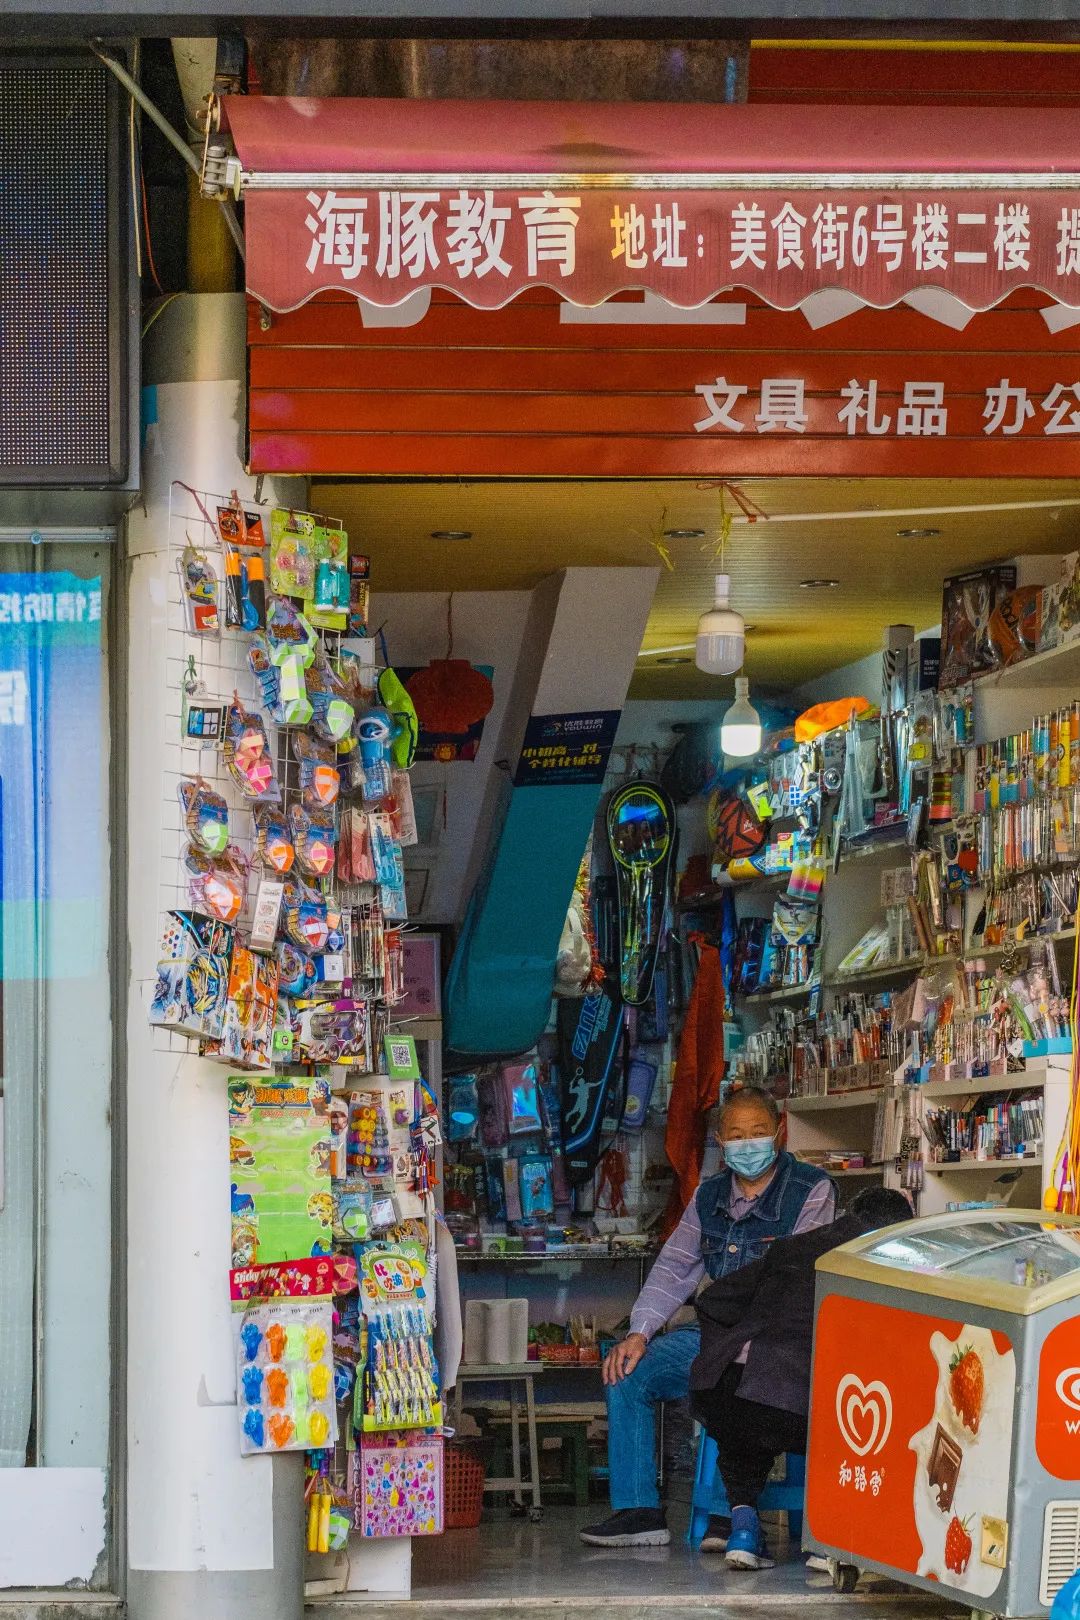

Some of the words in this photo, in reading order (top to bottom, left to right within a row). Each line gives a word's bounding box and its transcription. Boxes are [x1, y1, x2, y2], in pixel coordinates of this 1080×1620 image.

[305, 190, 582, 279] 海豚教育
[694, 376, 809, 434] 文具
[837, 378, 948, 436] 礼品
[982, 378, 1080, 436] 办公
